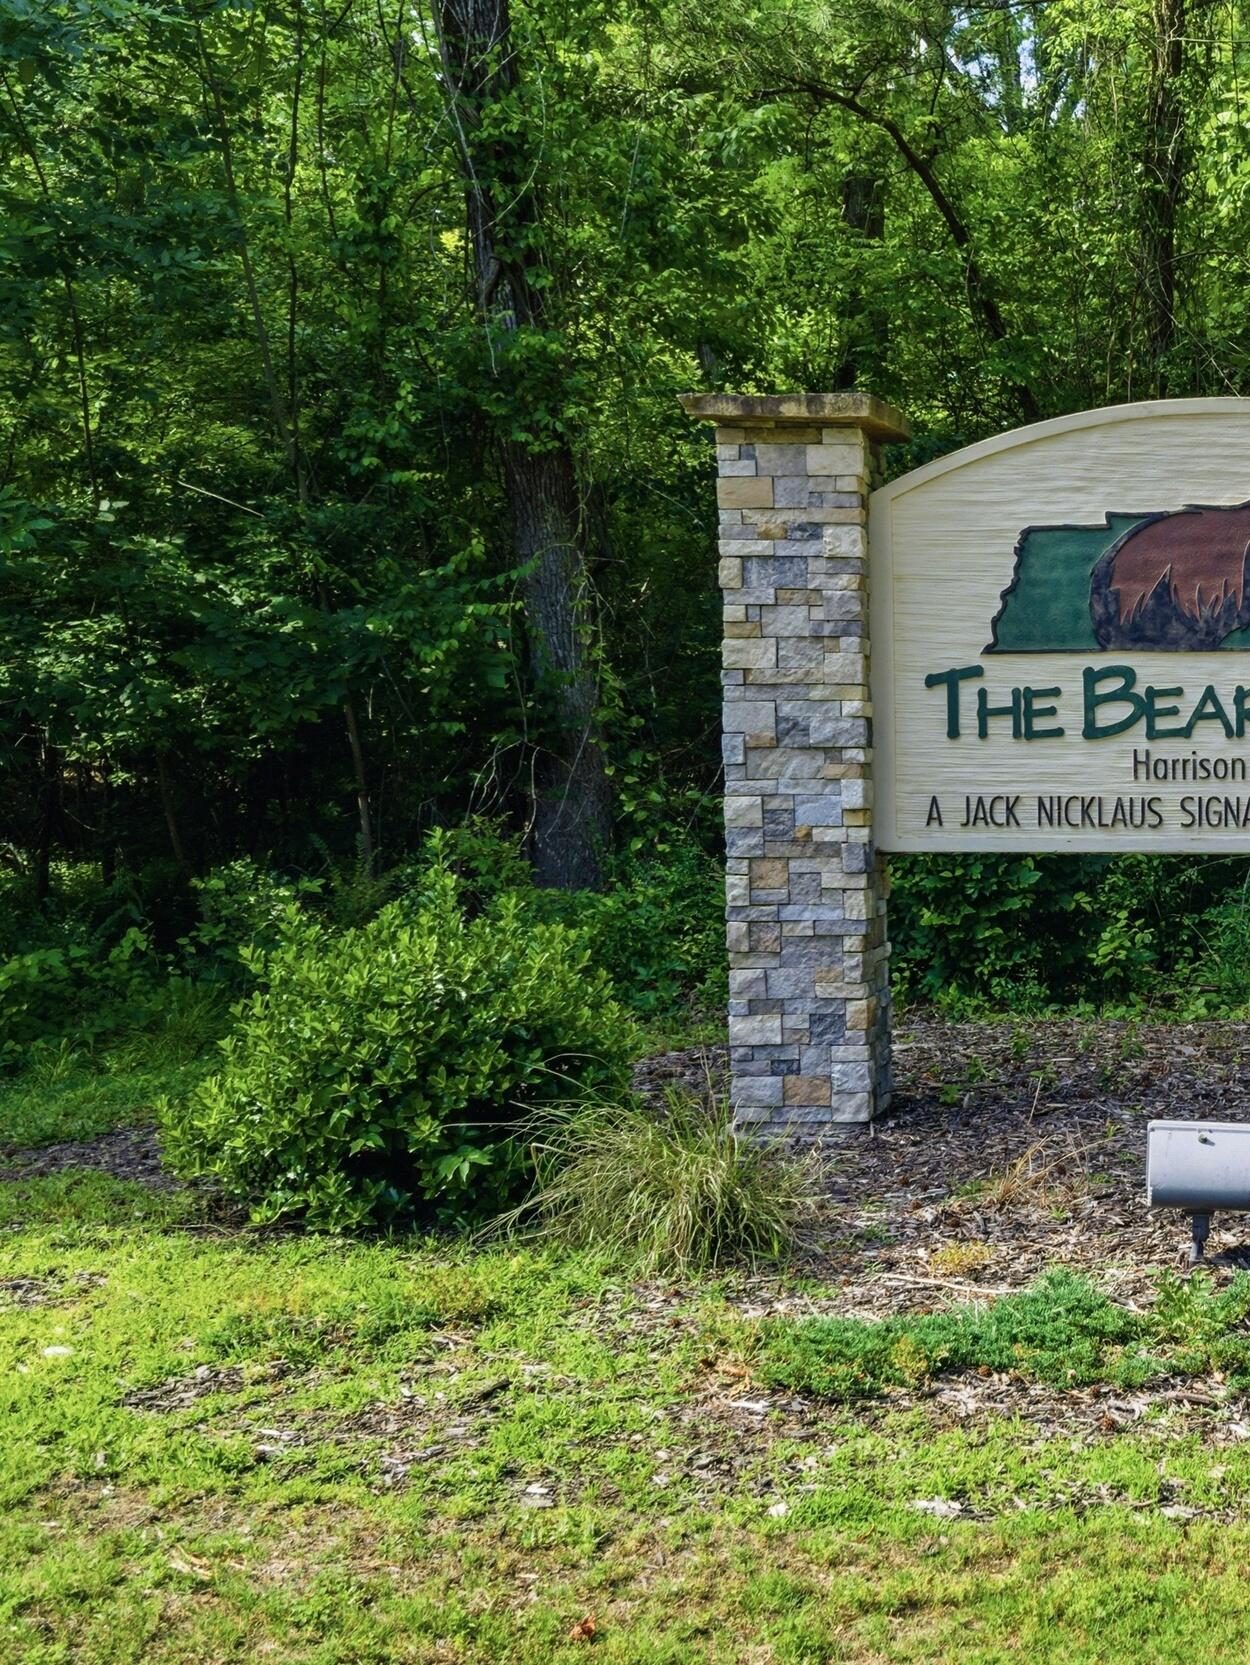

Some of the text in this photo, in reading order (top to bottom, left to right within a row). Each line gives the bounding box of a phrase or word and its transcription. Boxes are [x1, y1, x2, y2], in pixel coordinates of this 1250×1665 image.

[924, 664, 1065, 740] THE
[1133, 748, 1246, 780] Harrison
[926, 796, 943, 827] A
[961, 796, 1020, 827] JACK
[1037, 796, 1163, 828] NICKLAUS
